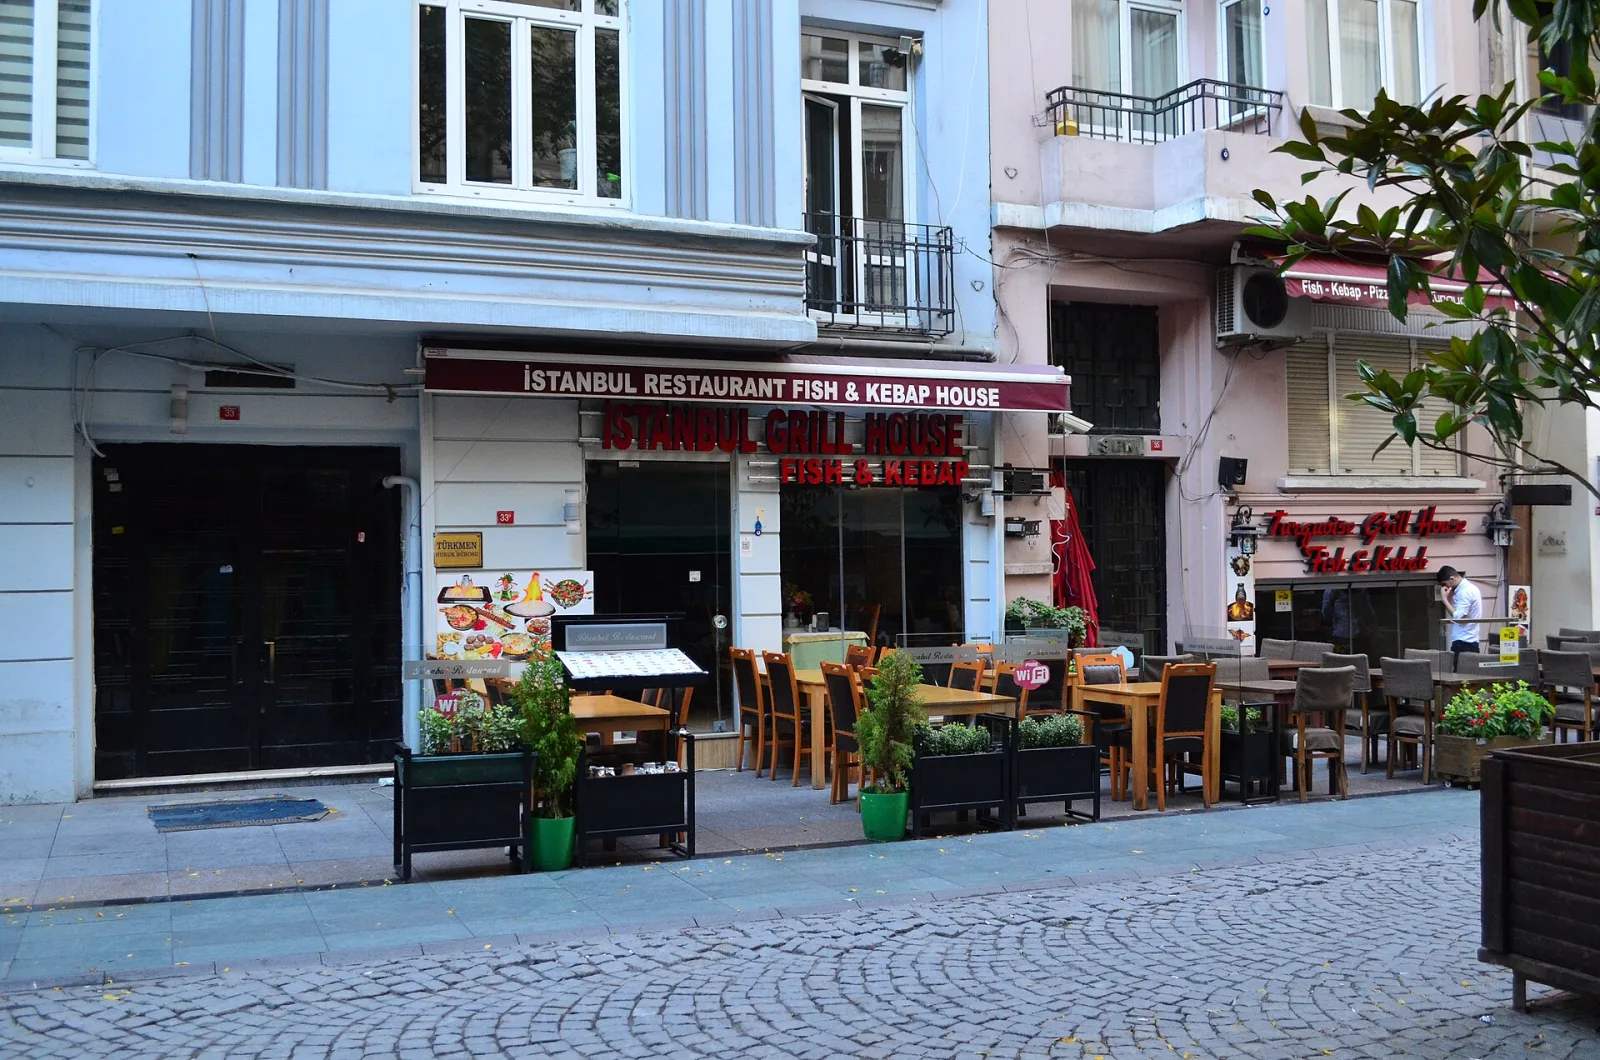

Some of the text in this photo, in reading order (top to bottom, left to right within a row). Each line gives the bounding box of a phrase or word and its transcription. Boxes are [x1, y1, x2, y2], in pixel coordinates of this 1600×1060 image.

[1302, 280, 1324, 295] Fish
[1331, 282, 1362, 300] Kebap
[1369, 285, 1390, 299] Pizz
[524, 365, 1000, 406] İSTANBUL RESTAURANT FISH & KEBAP HOUSE
[224, 409, 235, 417] 33
[766, 408, 853, 455] GRILL
[865, 412, 964, 456] HOUSE
[781, 458, 969, 486] FISH & KEBAP
[1264, 505, 1468, 548] Turquoise Grill House
[437, 540, 477, 550] TÜRKMEN
[1301, 546, 1347, 573] Fish
[1351, 550, 1370, 571] &
